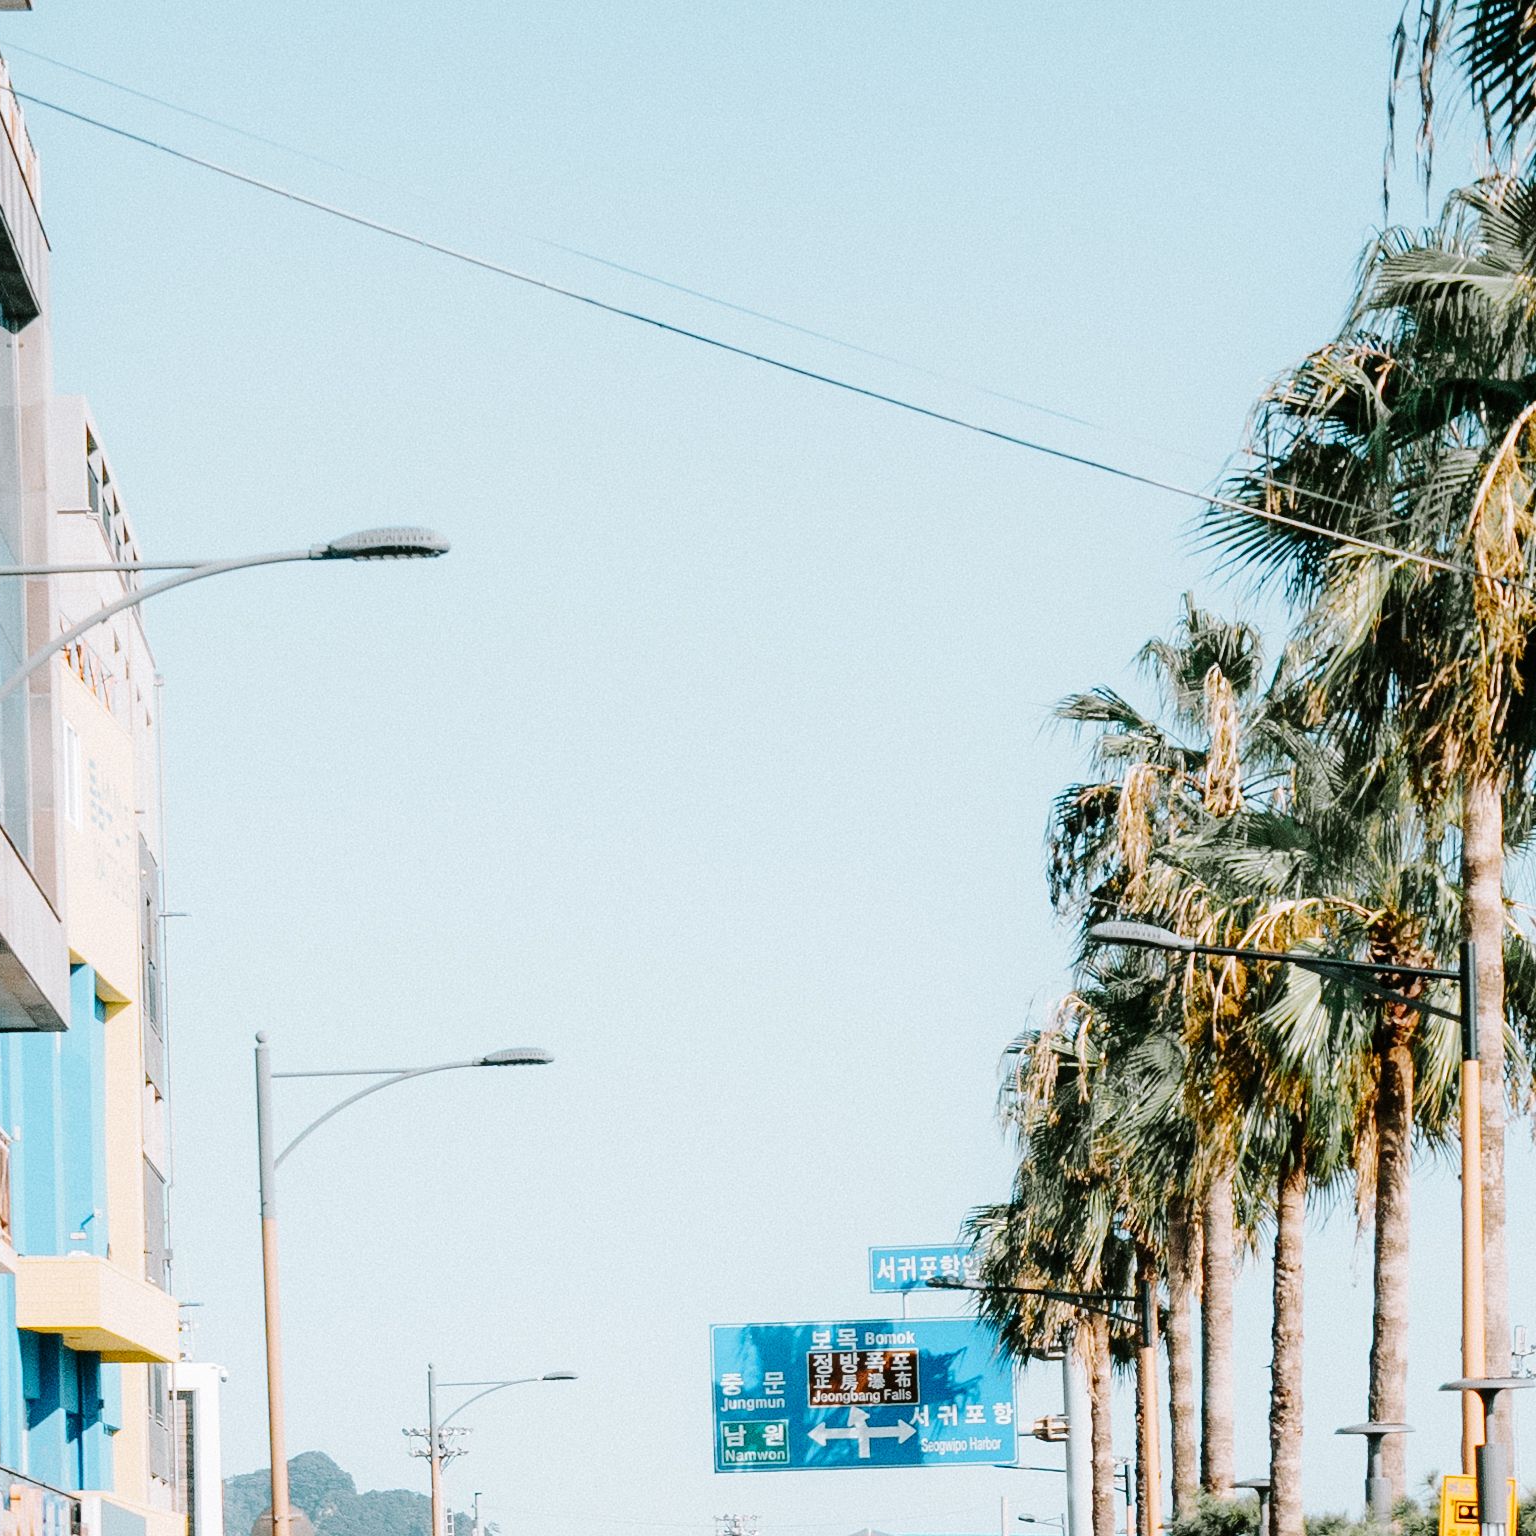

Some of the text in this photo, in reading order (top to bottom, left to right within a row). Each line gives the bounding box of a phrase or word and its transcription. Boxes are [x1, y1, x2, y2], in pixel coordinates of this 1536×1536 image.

[810, 1328, 916, 1350] 보목 Bomok
[813, 1352, 912, 1374] 정방폭포
[720, 1397, 786, 1412] Jungmun
[813, 1388, 912, 1404] Jeongbang Falls
[910, 1402, 1014, 1427] 서귀포항
[921, 1437, 1002, 1455] Seogwipo Harbor
[724, 1449, 786, 1463] Namwon
